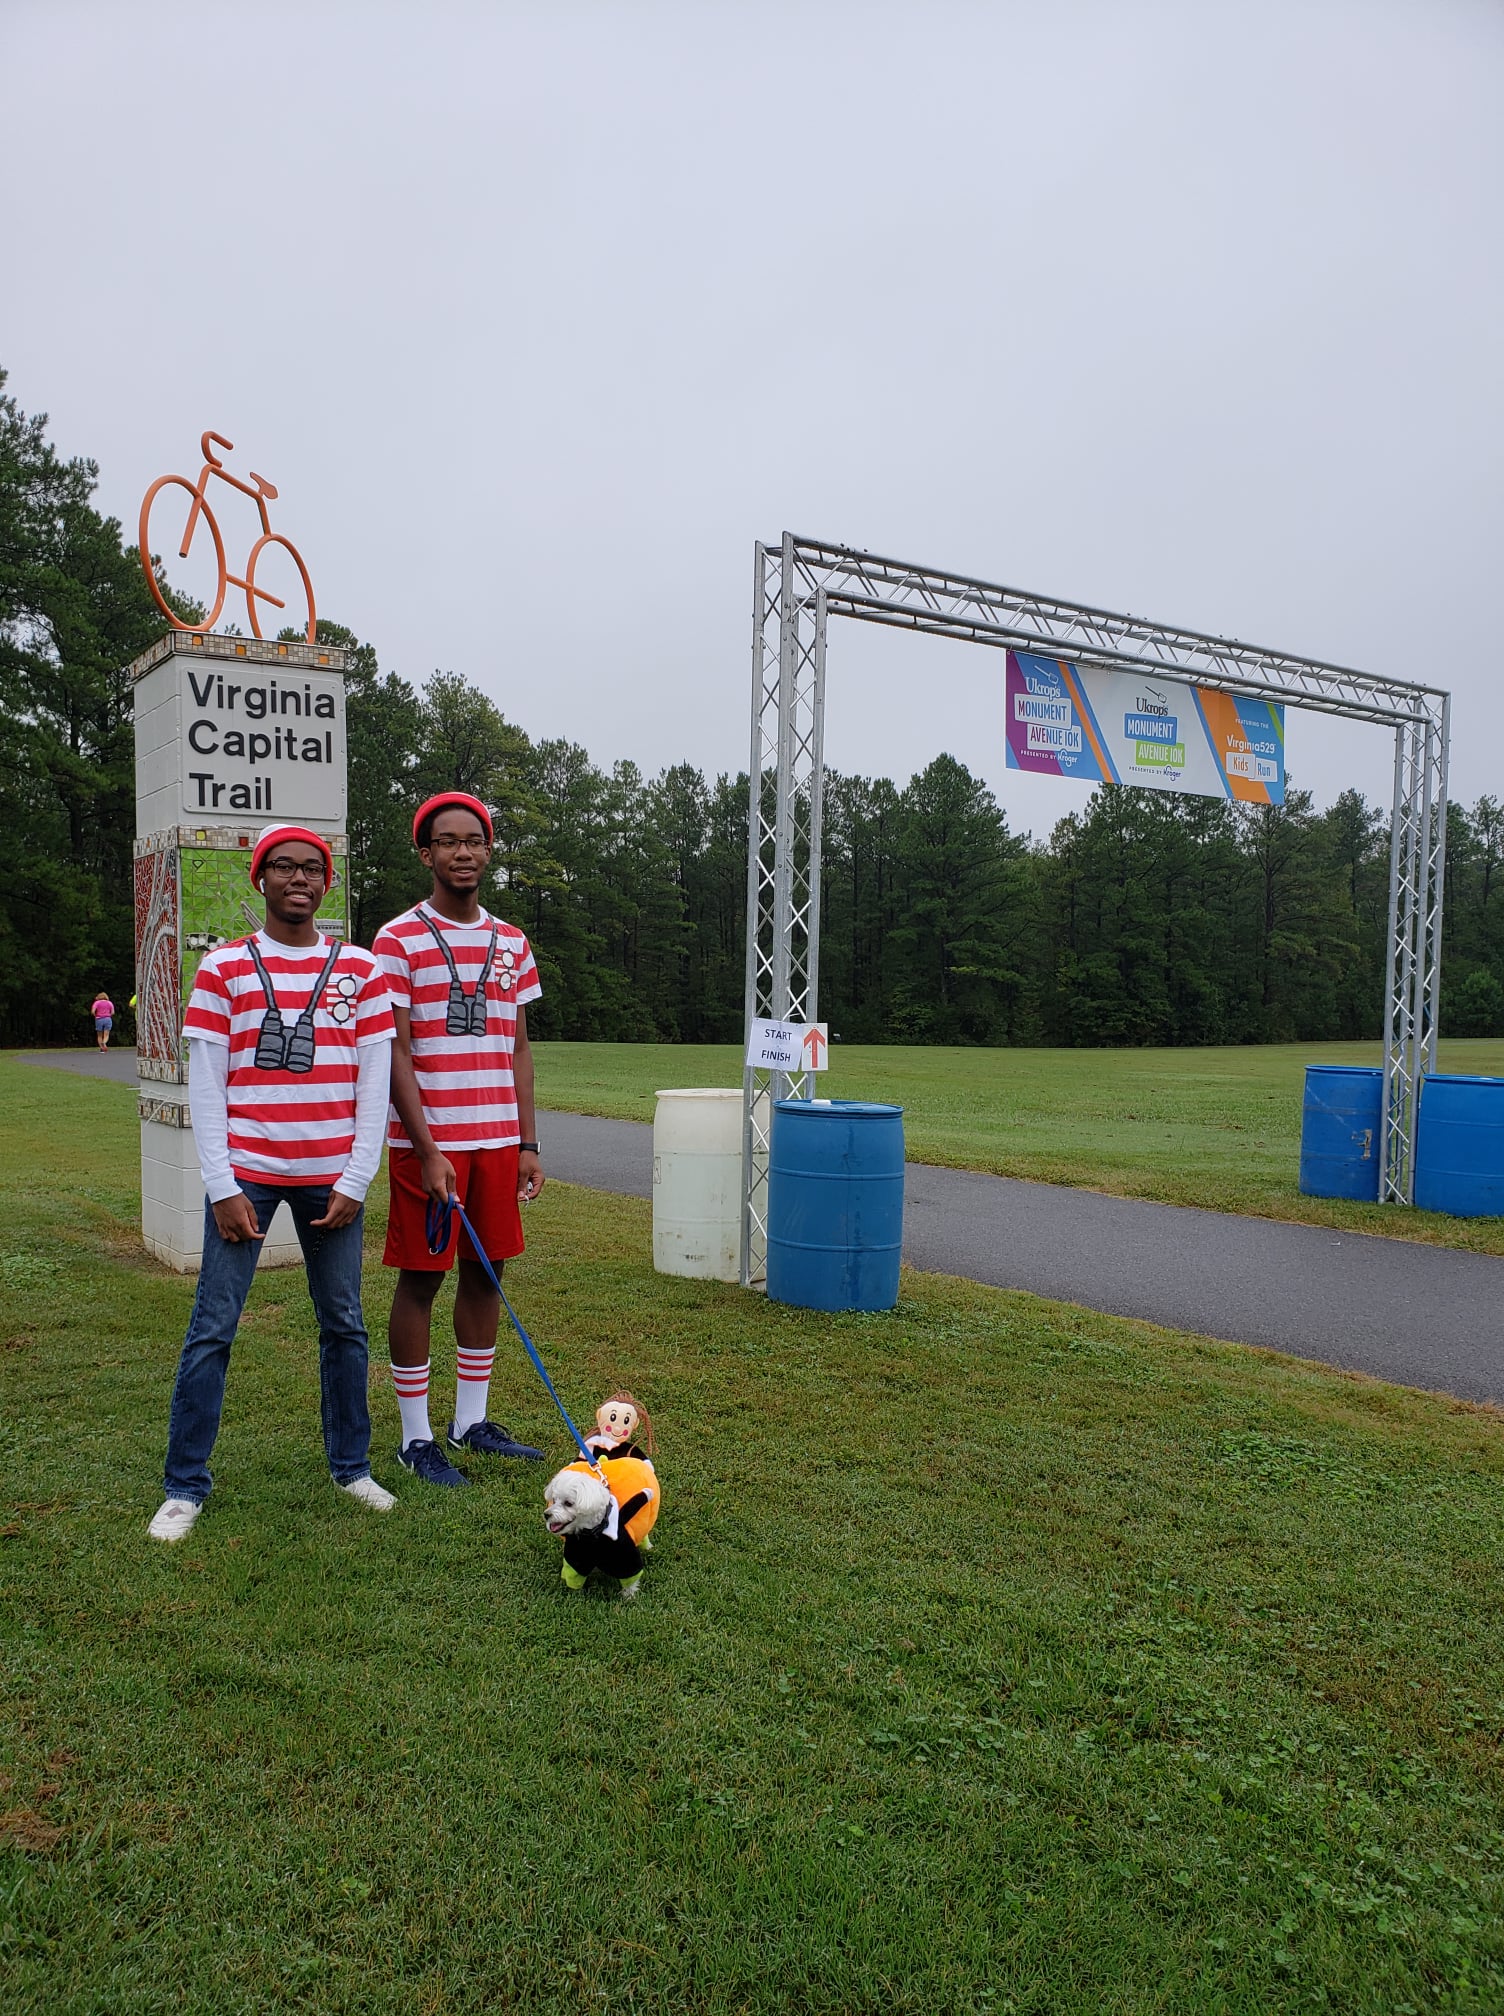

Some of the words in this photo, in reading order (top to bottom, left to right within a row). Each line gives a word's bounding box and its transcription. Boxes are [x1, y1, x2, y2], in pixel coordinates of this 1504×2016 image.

[187, 671, 335, 719] Virginia
[1025, 677, 1060, 701] Ukrop's
[1018, 700, 1067, 722] MONUMENT
[1136, 697, 1168, 719] Ukrop's
[1030, 726, 1062, 746] AVENUE
[1064, 731, 1079, 748] 10K
[1127, 719, 1174, 739] MONUMENT
[188, 720, 332, 764] Capital
[1226, 734, 1275, 754] Virginia529
[1020, 749, 1049, 759] PRESENTED
[1057, 749, 1078, 767] Kroger
[1138, 744, 1169, 761] AVENUE
[1170, 748, 1183, 763] 10K
[1128, 766, 1155, 774] PRESENTED
[1163, 765, 1182, 781] Kroger
[1233, 756, 1249, 772] Kids
[1257, 762, 1271, 777] Run
[189, 773, 272, 810] Trail
[764, 1028, 793, 1041] START
[761, 1049, 791, 1062] FINISH
